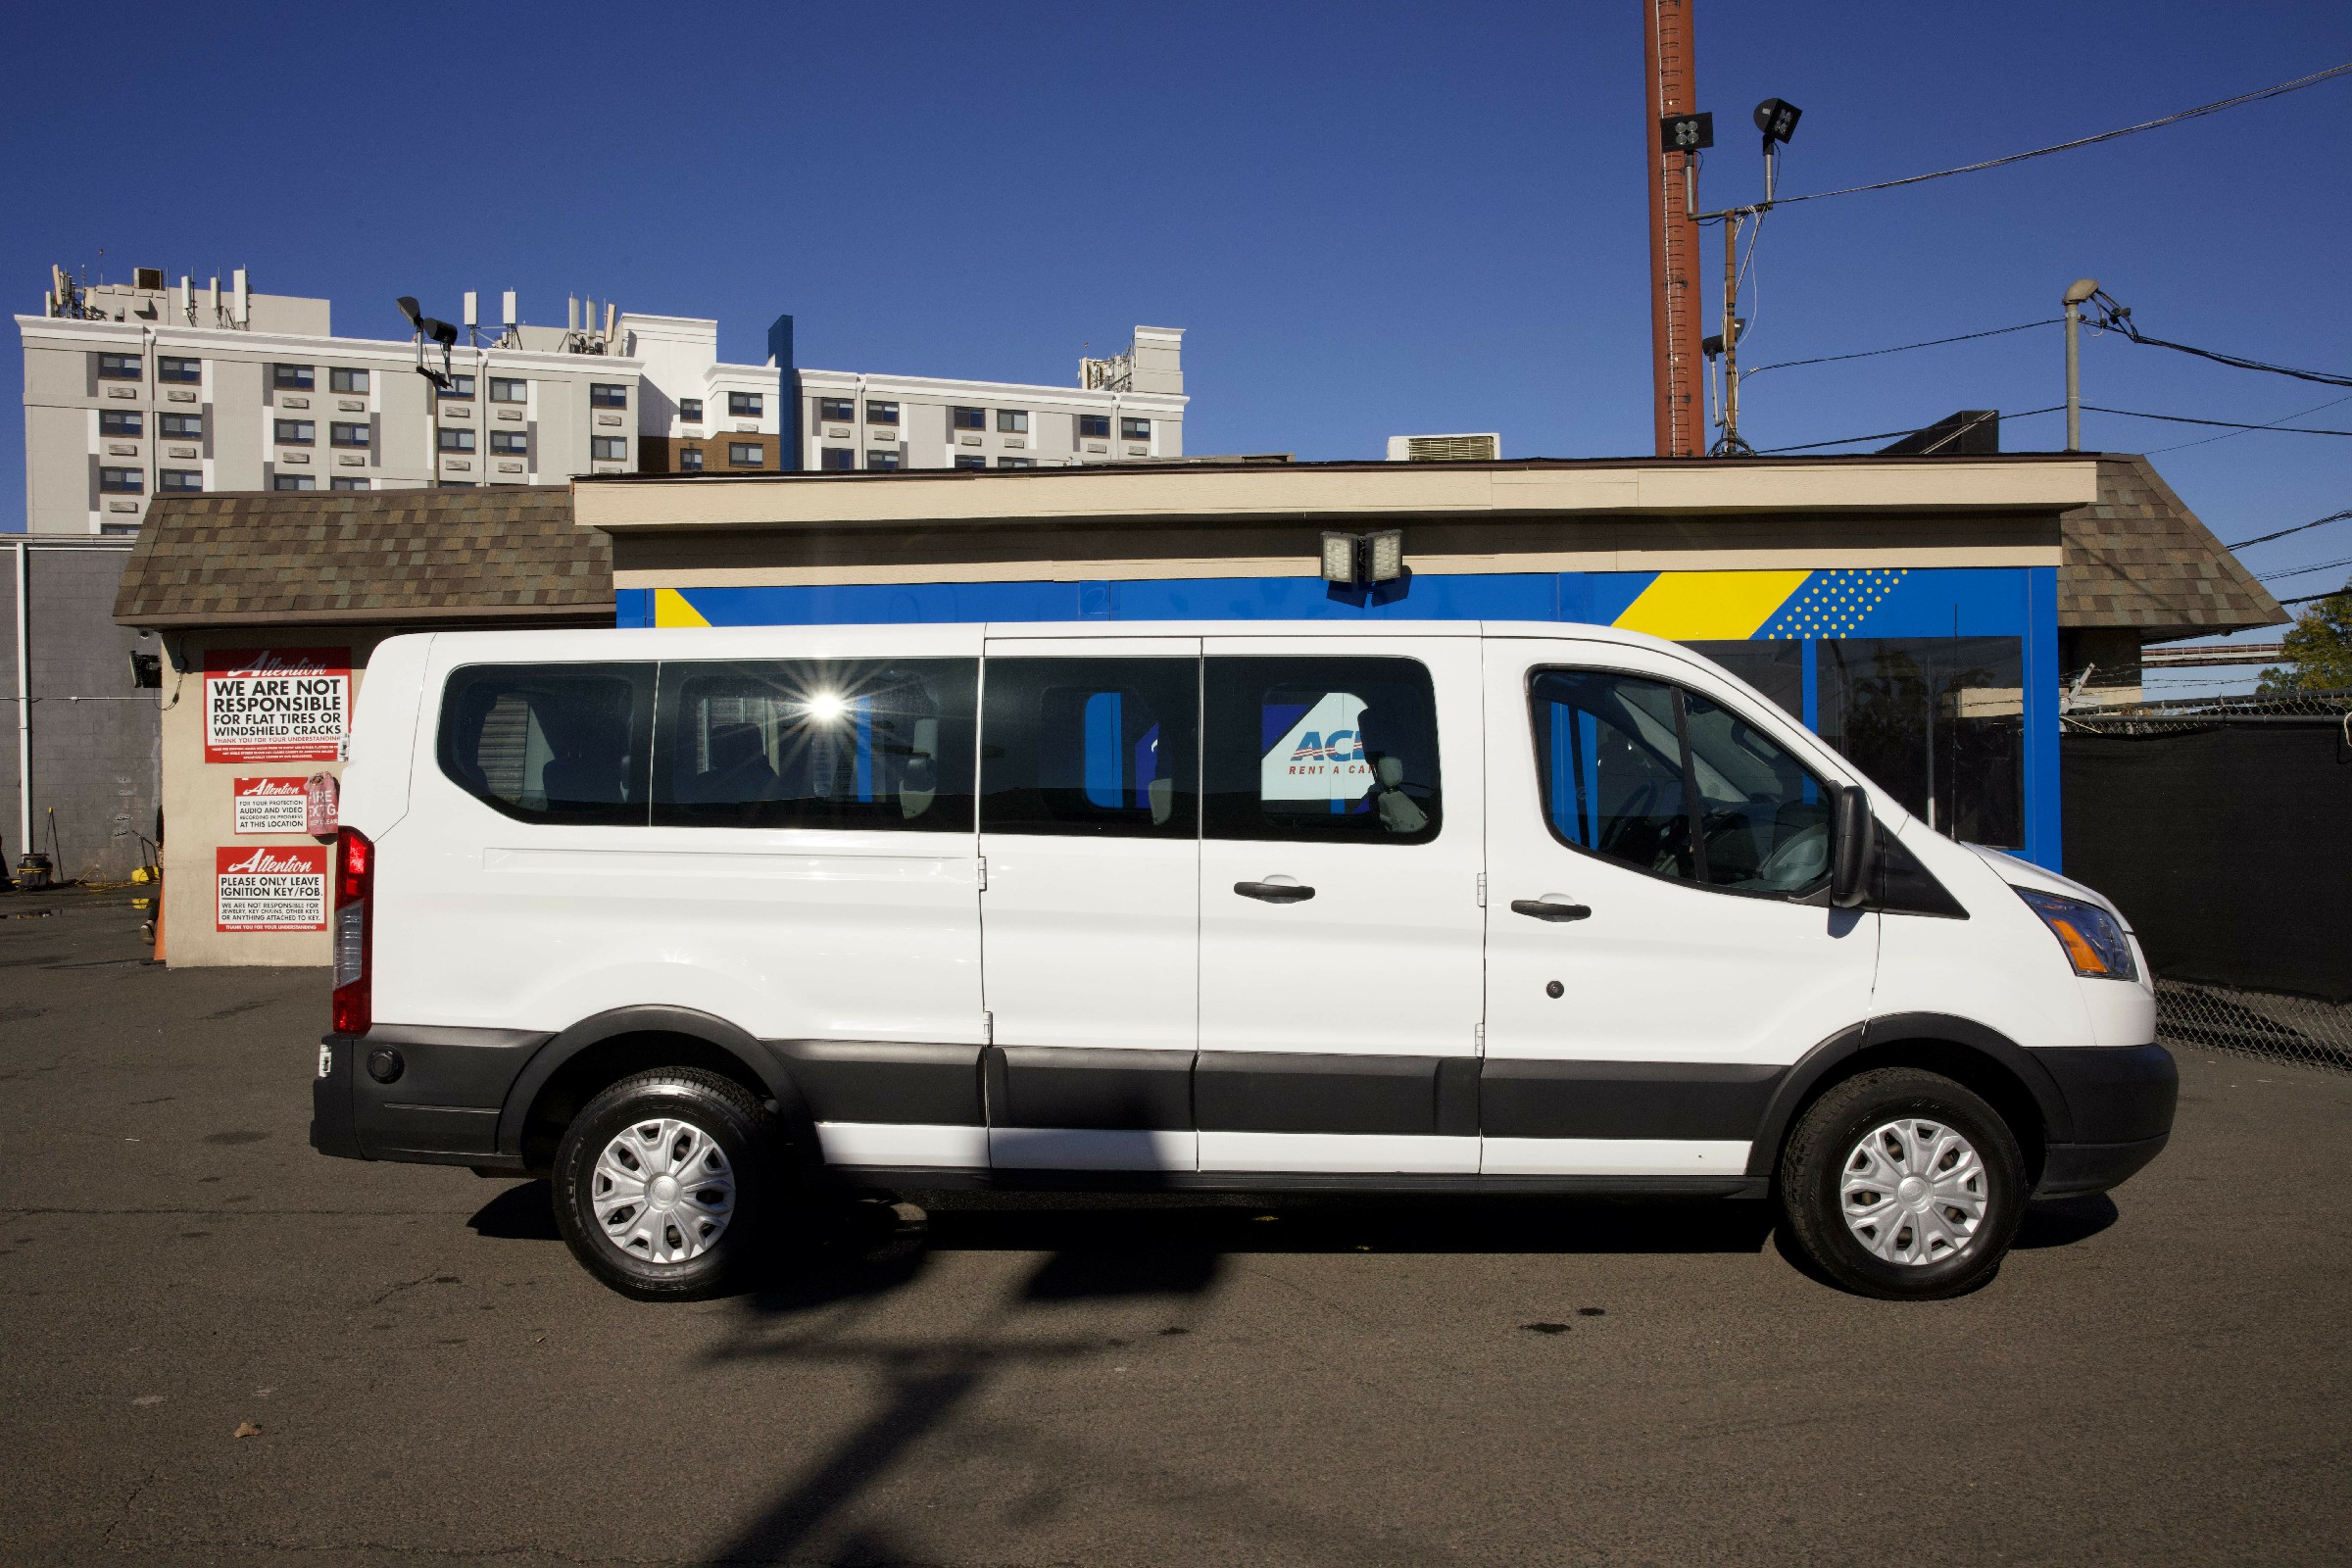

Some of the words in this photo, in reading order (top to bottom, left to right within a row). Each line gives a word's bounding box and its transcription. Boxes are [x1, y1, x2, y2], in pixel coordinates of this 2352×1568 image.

[227, 651, 327, 677] Attention
[214, 681, 245, 696] WE
[252, 680, 289, 696] ARE
[296, 678, 340, 695] NOT
[214, 697, 341, 712] RESPONSIBLE
[214, 713, 240, 725] FOR
[245, 713, 275, 725] FLAT
[280, 713, 316, 724] TIRES
[320, 712, 341, 723] OR
[214, 725, 289, 736] WINDSHIELD
[293, 724, 341, 735] CRACKS
[1289, 765, 1324, 774] RENT
[1333, 765, 1340, 774] A
[243, 779, 300, 795] Attention
[227, 849, 313, 872] Attention
[221, 877, 256, 886] PLEASE
[260, 877, 287, 886] ONLY
[290, 877, 319, 886] LEAVE
[221, 887, 270, 897] IGNITION
[274, 887, 323, 897] KEY/FOB.
